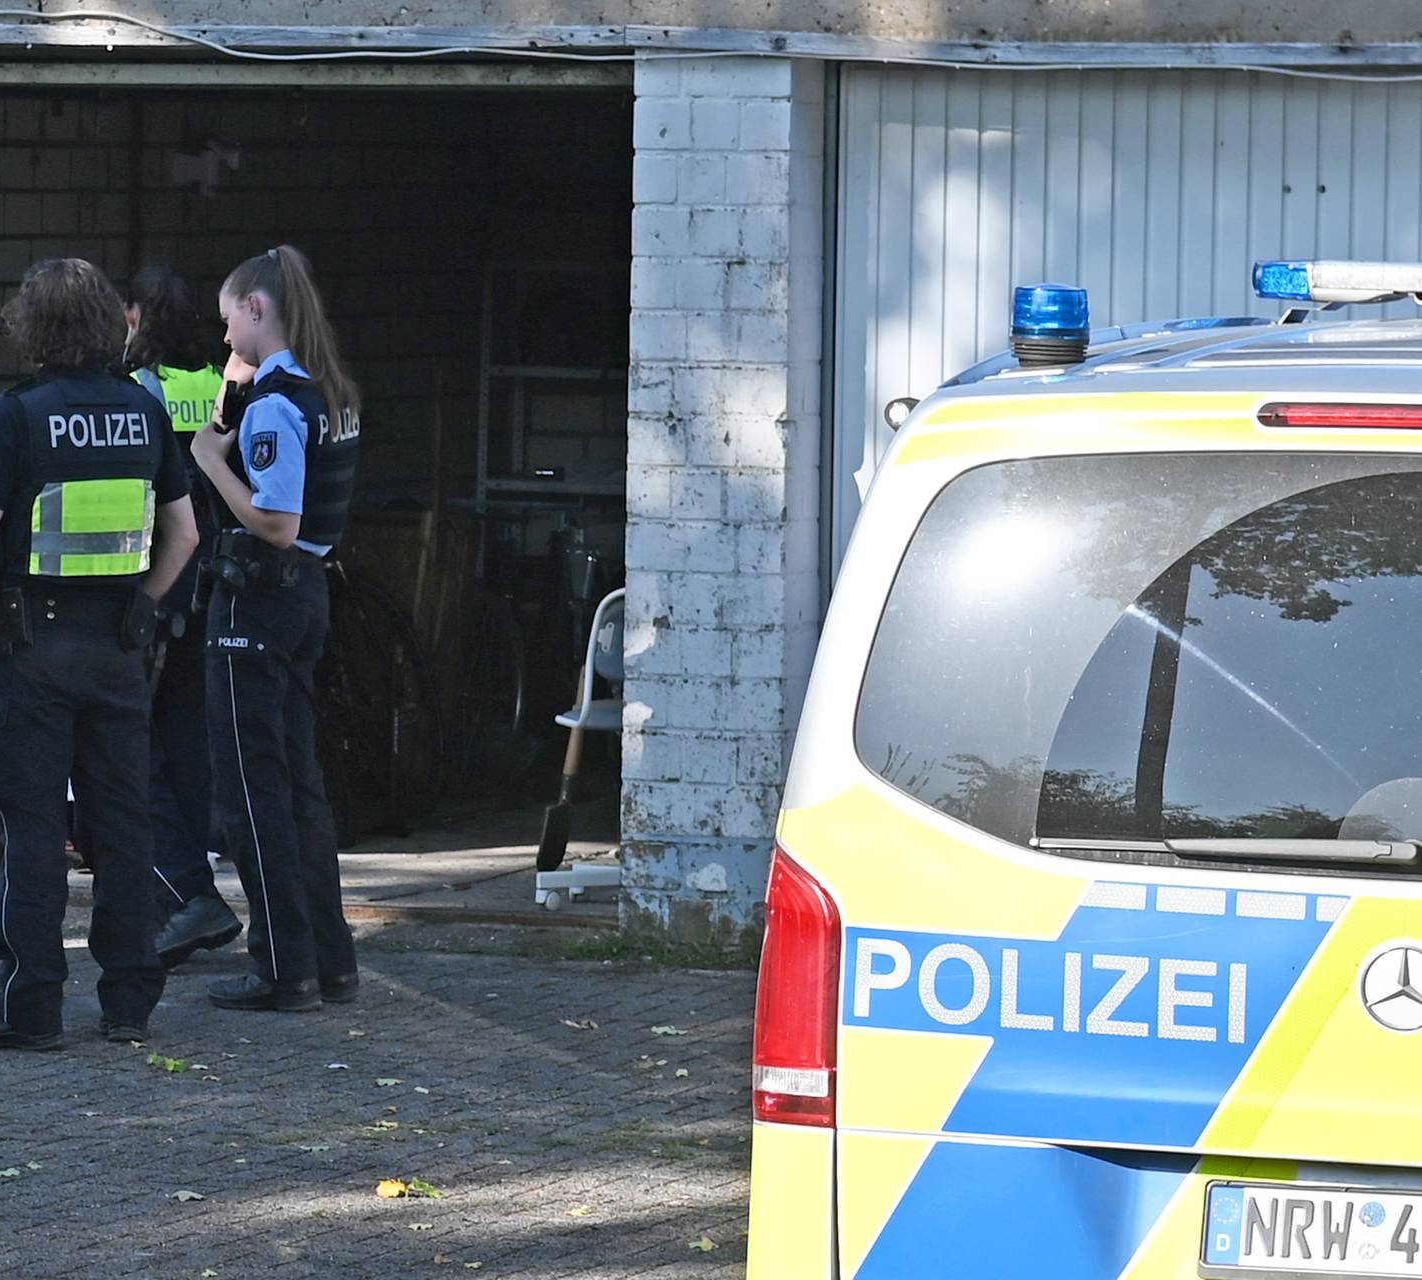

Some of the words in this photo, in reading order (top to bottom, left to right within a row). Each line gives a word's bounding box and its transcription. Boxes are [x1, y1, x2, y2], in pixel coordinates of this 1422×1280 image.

[167, 399, 216, 423] POLIZ
[48, 413, 150, 448] POLIZEI
[218, 637, 248, 648] POLIZEI
[852, 937, 1248, 1044] POLIZEI
[1216, 1233, 1231, 1252] D
[1243, 1197, 1354, 1261] NRW
[1389, 1204, 1420, 1264] 4
